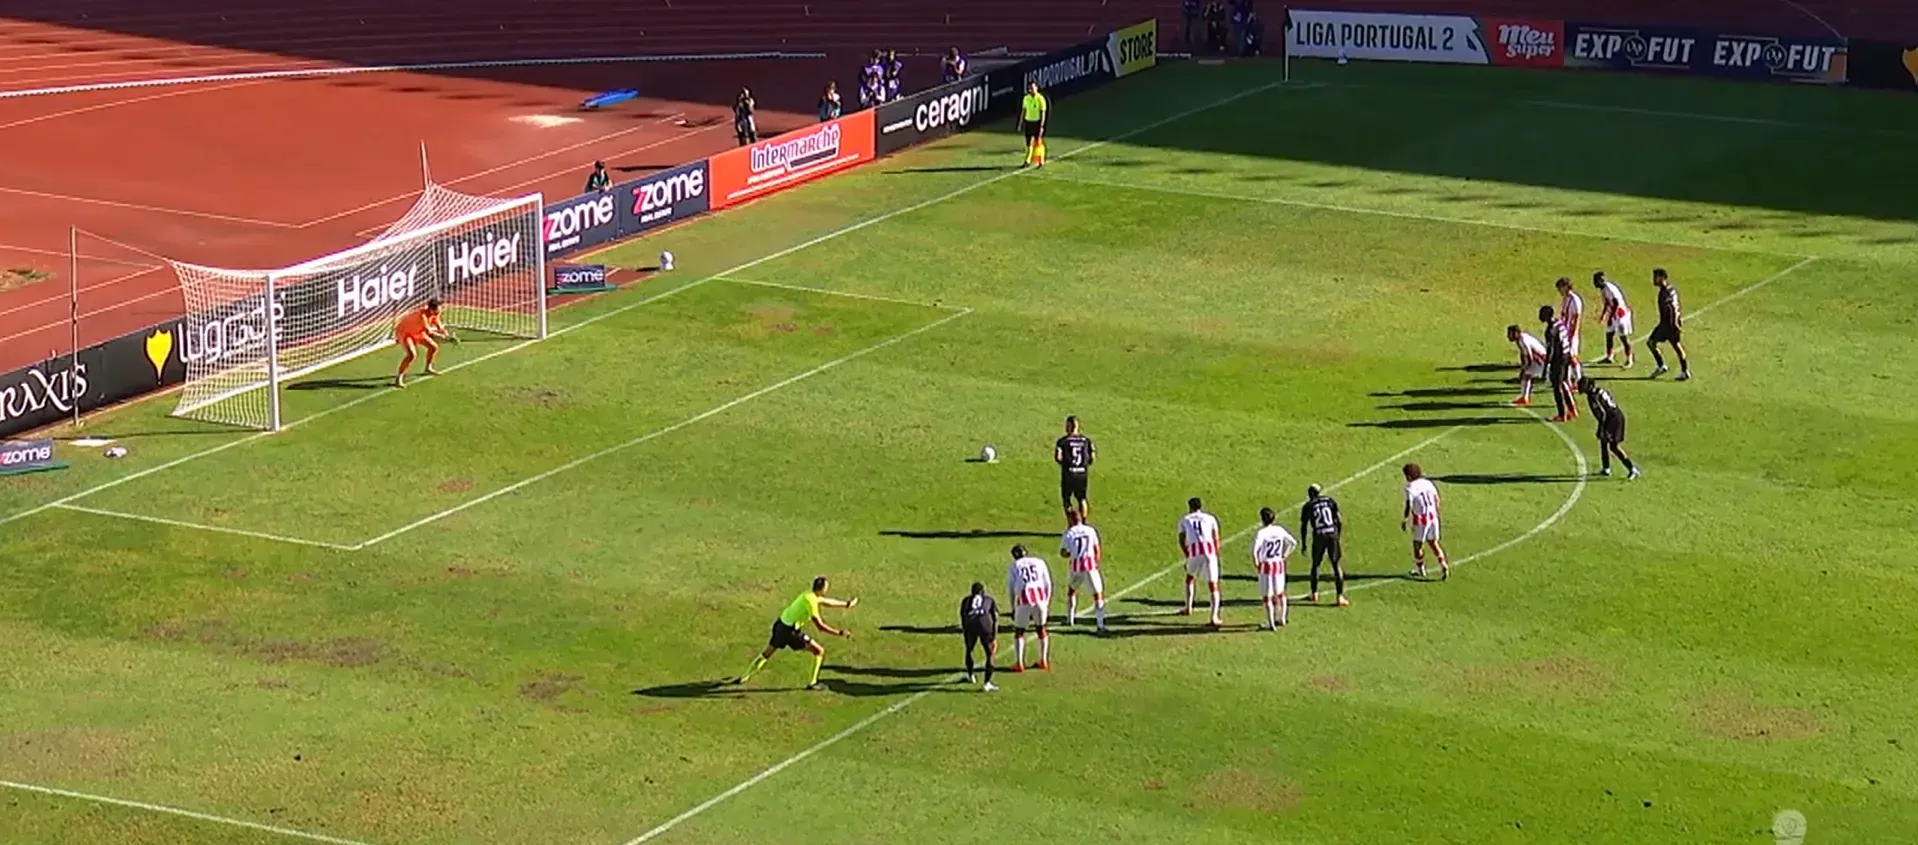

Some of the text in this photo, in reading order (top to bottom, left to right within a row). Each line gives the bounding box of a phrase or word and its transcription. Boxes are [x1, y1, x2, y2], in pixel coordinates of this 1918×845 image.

[1296, 22, 1454, 50] LIGA PORTUGAL 2
[1498, 24, 1555, 45] Meu
[1120, 31, 1154, 65] STORE
[1506, 42, 1555, 60] super
[916, 74, 989, 132] ceragni
[448, 231, 520, 284] Haier
[337, 263, 417, 318] Haier
[1072, 447, 1082, 466] 5
[1192, 520, 1203, 537] 4
[1313, 506, 1333, 529] 20
[1266, 540, 1282, 559] 22
[1020, 565, 1039, 583] 35
